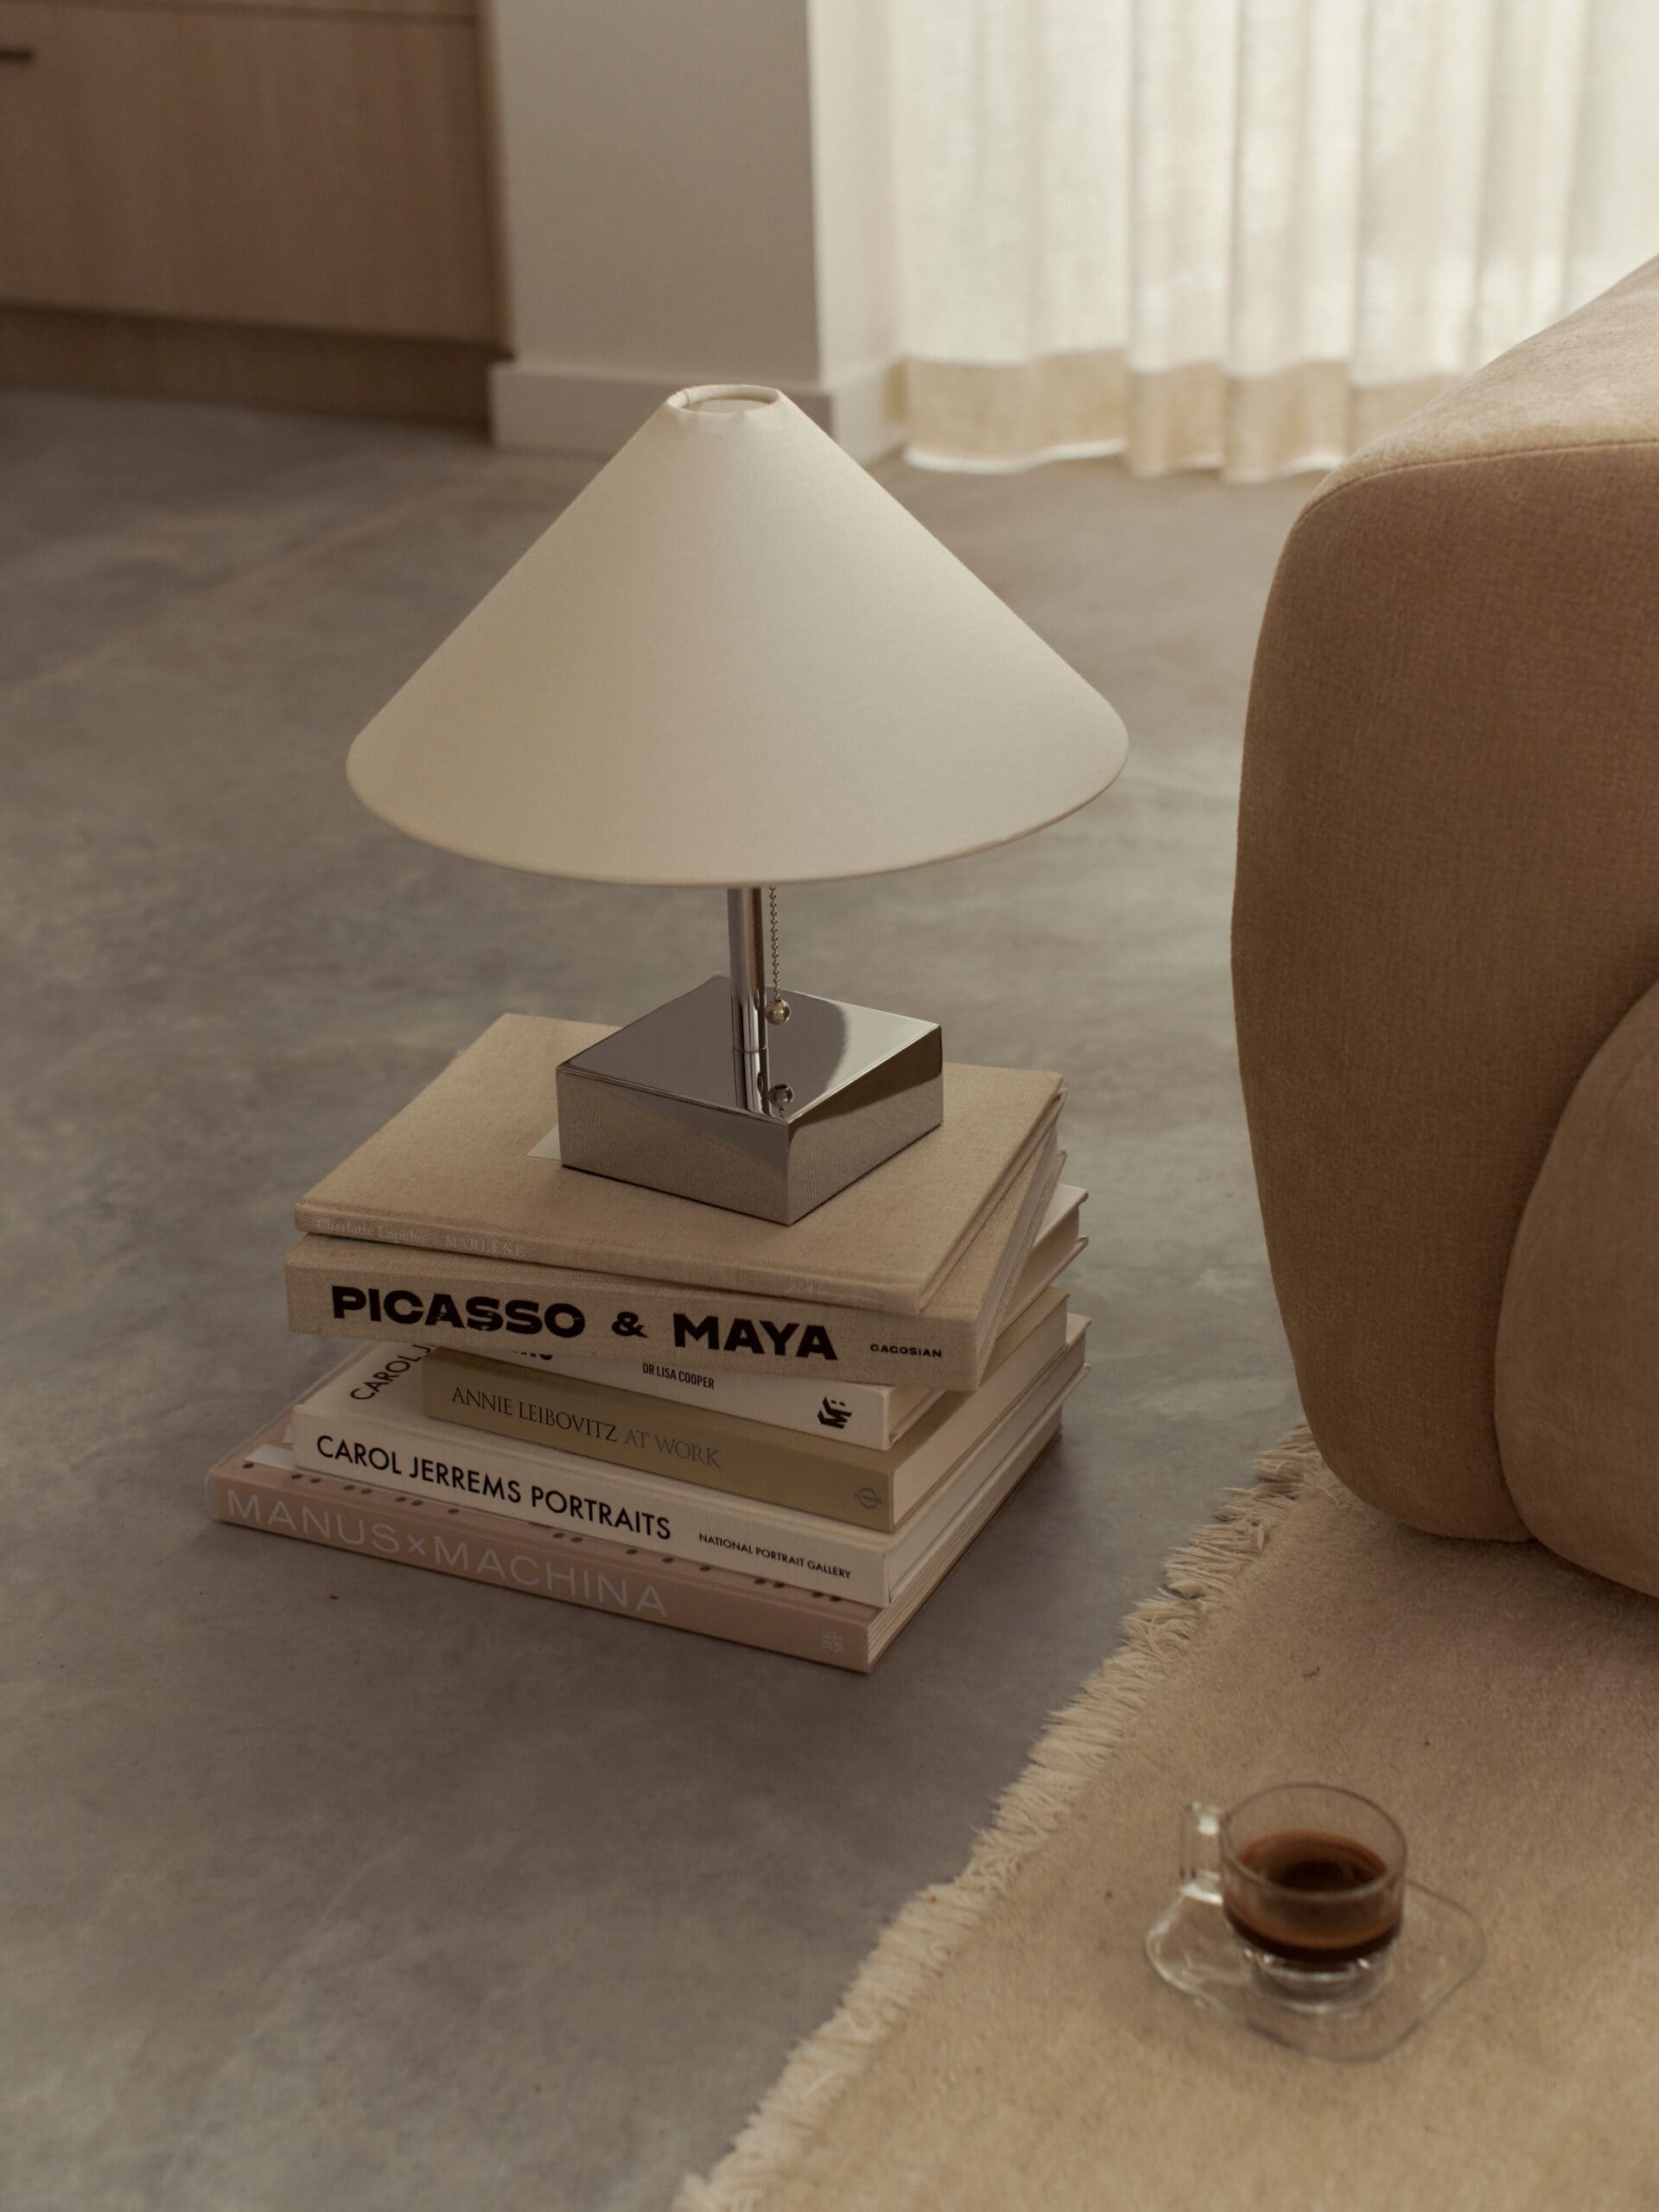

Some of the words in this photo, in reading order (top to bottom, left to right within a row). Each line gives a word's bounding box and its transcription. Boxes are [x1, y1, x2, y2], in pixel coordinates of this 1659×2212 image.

[332, 1286, 585, 1338] PICASSO
[612, 1312, 647, 1338] &
[673, 1313, 838, 1361] MAYA
[870, 1344, 942, 1358] GAGOSIAN
[350, 1354, 421, 1401] CAROL
[642, 1363, 655, 1376] DR
[656, 1365, 677, 1381] LISA
[678, 1368, 715, 1389] COOPER
[451, 1386, 513, 1416] ANNIE
[518, 1401, 618, 1444] LEIBOVITZ
[624, 1428, 651, 1451] AT
[654, 1433, 721, 1468] WORK
[316, 1435, 402, 1475] CAROL
[409, 1457, 522, 1503] JERREMS
[531, 1485, 671, 1541] PORTRAITS
[699, 1533, 754, 1554] NATIONAL
[755, 1548, 805, 1567] PORTRAIT
[807, 1560, 851, 1580] GALLERY
